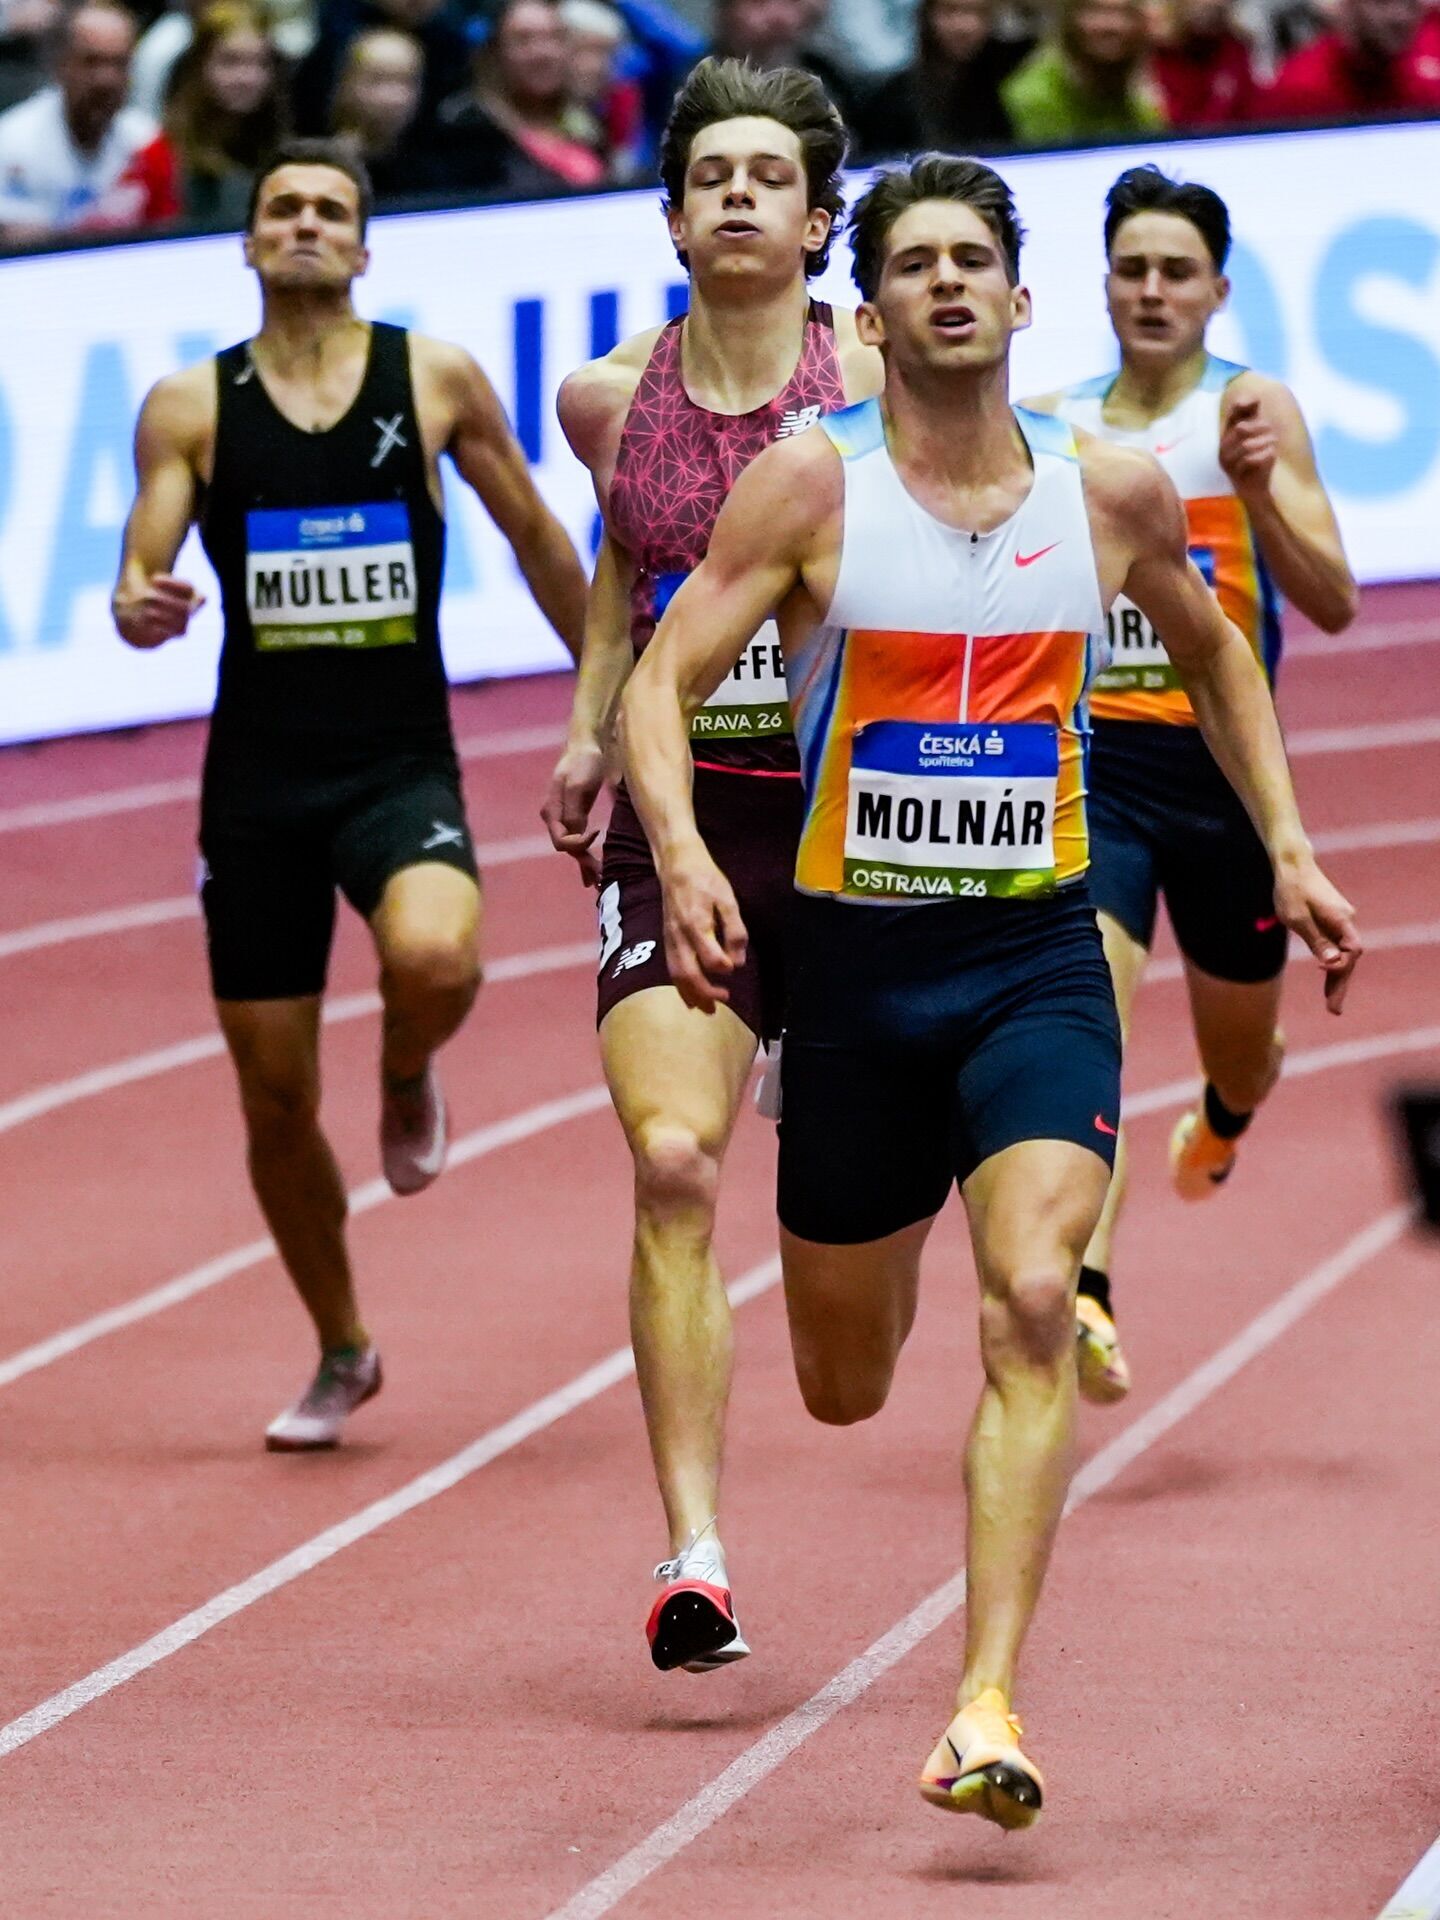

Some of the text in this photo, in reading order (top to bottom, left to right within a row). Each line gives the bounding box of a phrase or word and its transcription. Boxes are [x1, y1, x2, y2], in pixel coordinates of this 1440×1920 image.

[255, 558, 410, 609] MÜLLER
[757, 712, 782, 729] 26
[919, 733, 981, 755] ČESKÁ
[856, 788, 1046, 847] MOLNÁR
[852, 869, 988, 898] OSTRAVA 26
